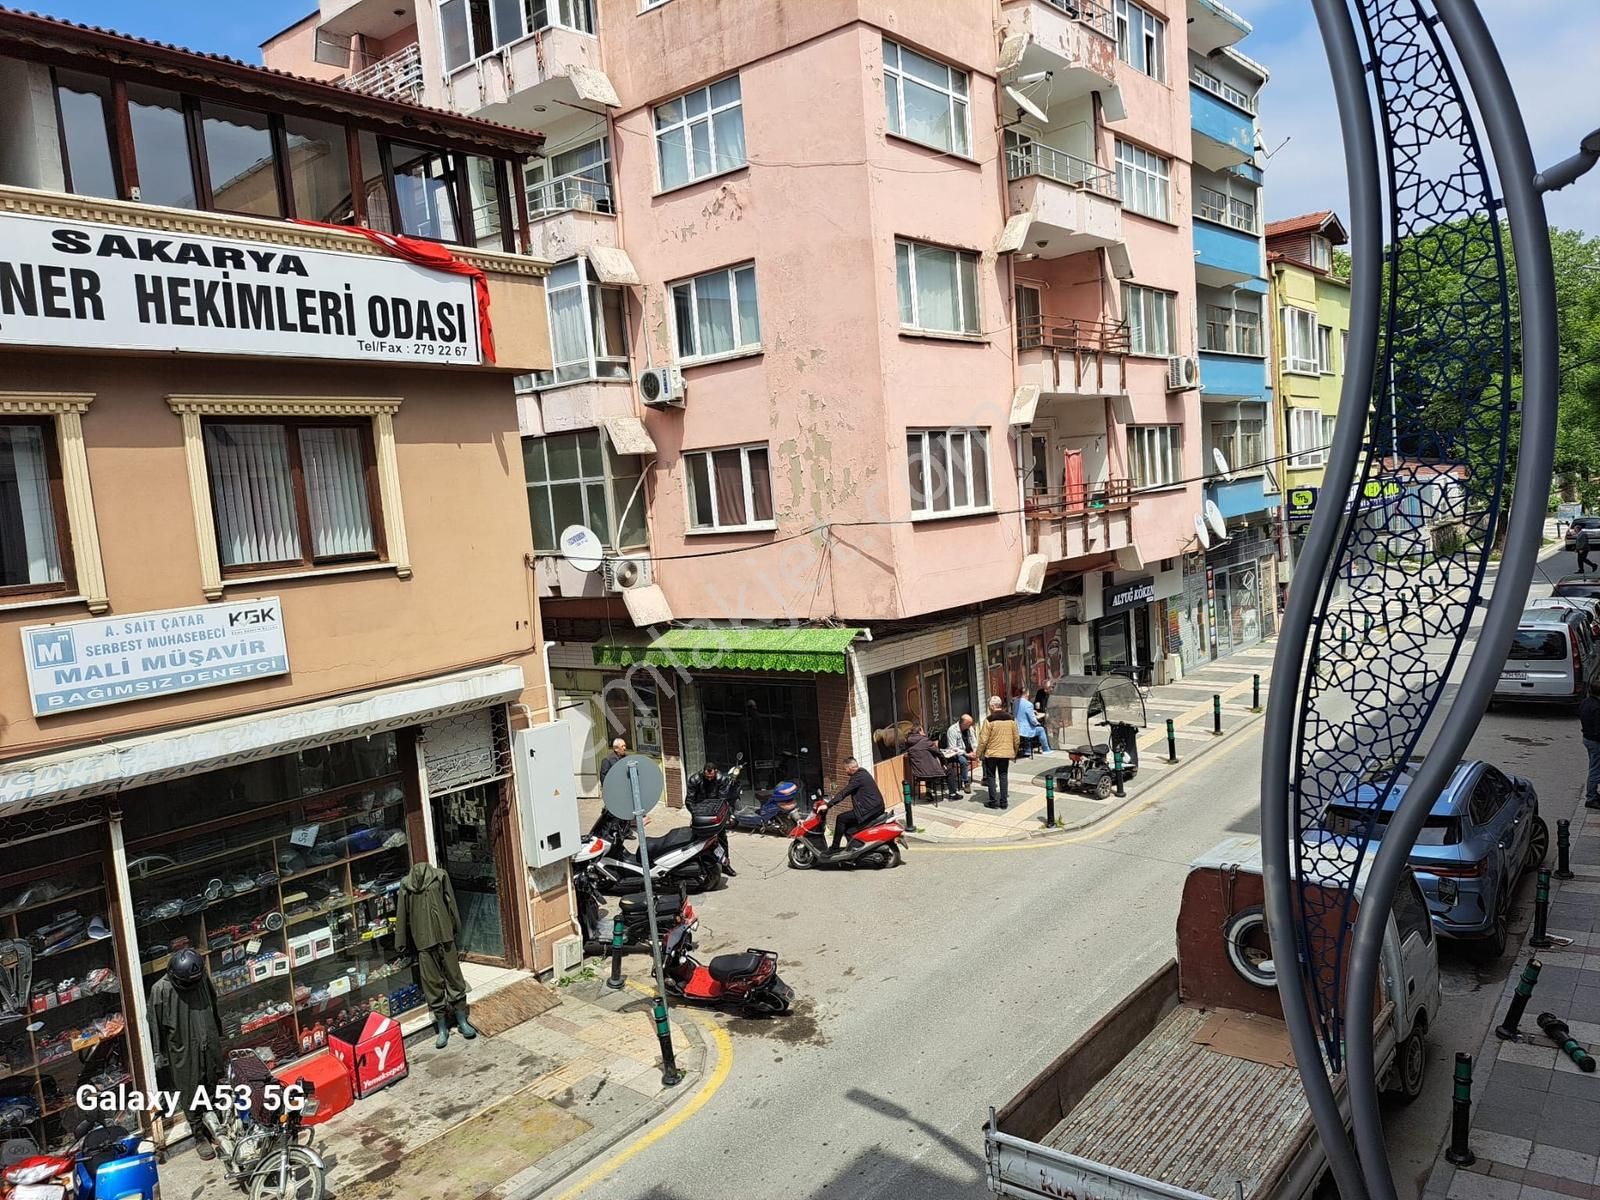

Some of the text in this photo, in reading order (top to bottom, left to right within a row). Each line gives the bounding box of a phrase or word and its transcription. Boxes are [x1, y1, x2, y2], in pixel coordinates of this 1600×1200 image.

[52, 229, 309, 277] SAKARYA
[134, 271, 356, 337] HEKİMLERİ
[367, 295, 467, 343] ODASI
[357, 340, 402, 353] Tel/Fax
[413, 344, 434, 355] 279
[438, 345, 451, 355] 22
[455, 346, 467, 356] 67
[86, 639, 142, 657] SERBEST
[147, 627, 226, 648] MUHASEBECİ
[105, 614, 205, 637] A. SAİT ÇATAR
[48, 660, 277, 706] BAĞIMSIZ DENETÇİ
[54, 640, 266, 685] MALİ MÜŞAVİR
